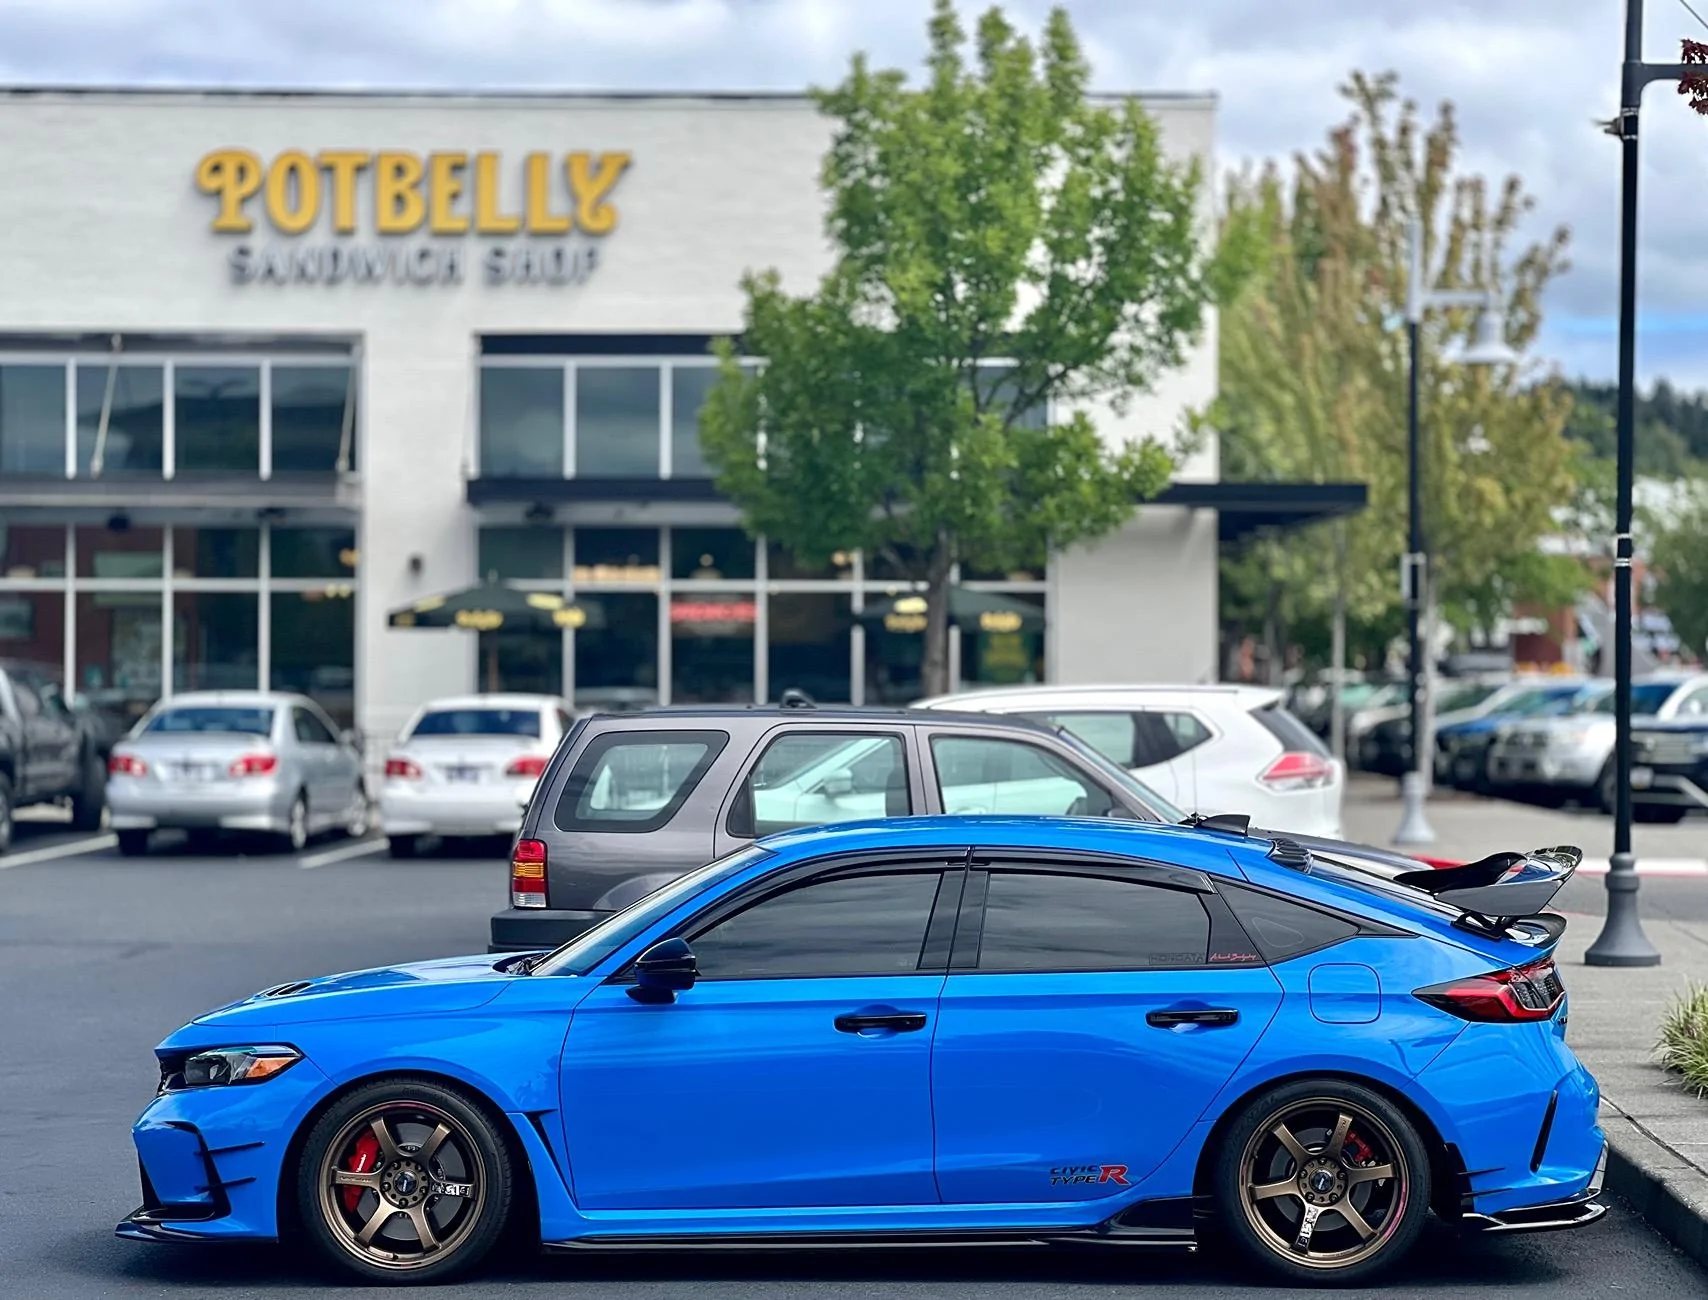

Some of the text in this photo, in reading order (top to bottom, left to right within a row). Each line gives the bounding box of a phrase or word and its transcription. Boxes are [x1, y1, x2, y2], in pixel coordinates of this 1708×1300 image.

[195, 148, 632, 235] POTBELLY
[228, 245, 602, 286] SANDWICH SHOP
[1050, 1165, 1097, 1175] CIVIC
[1050, 1164, 1131, 1186] TYPE R
